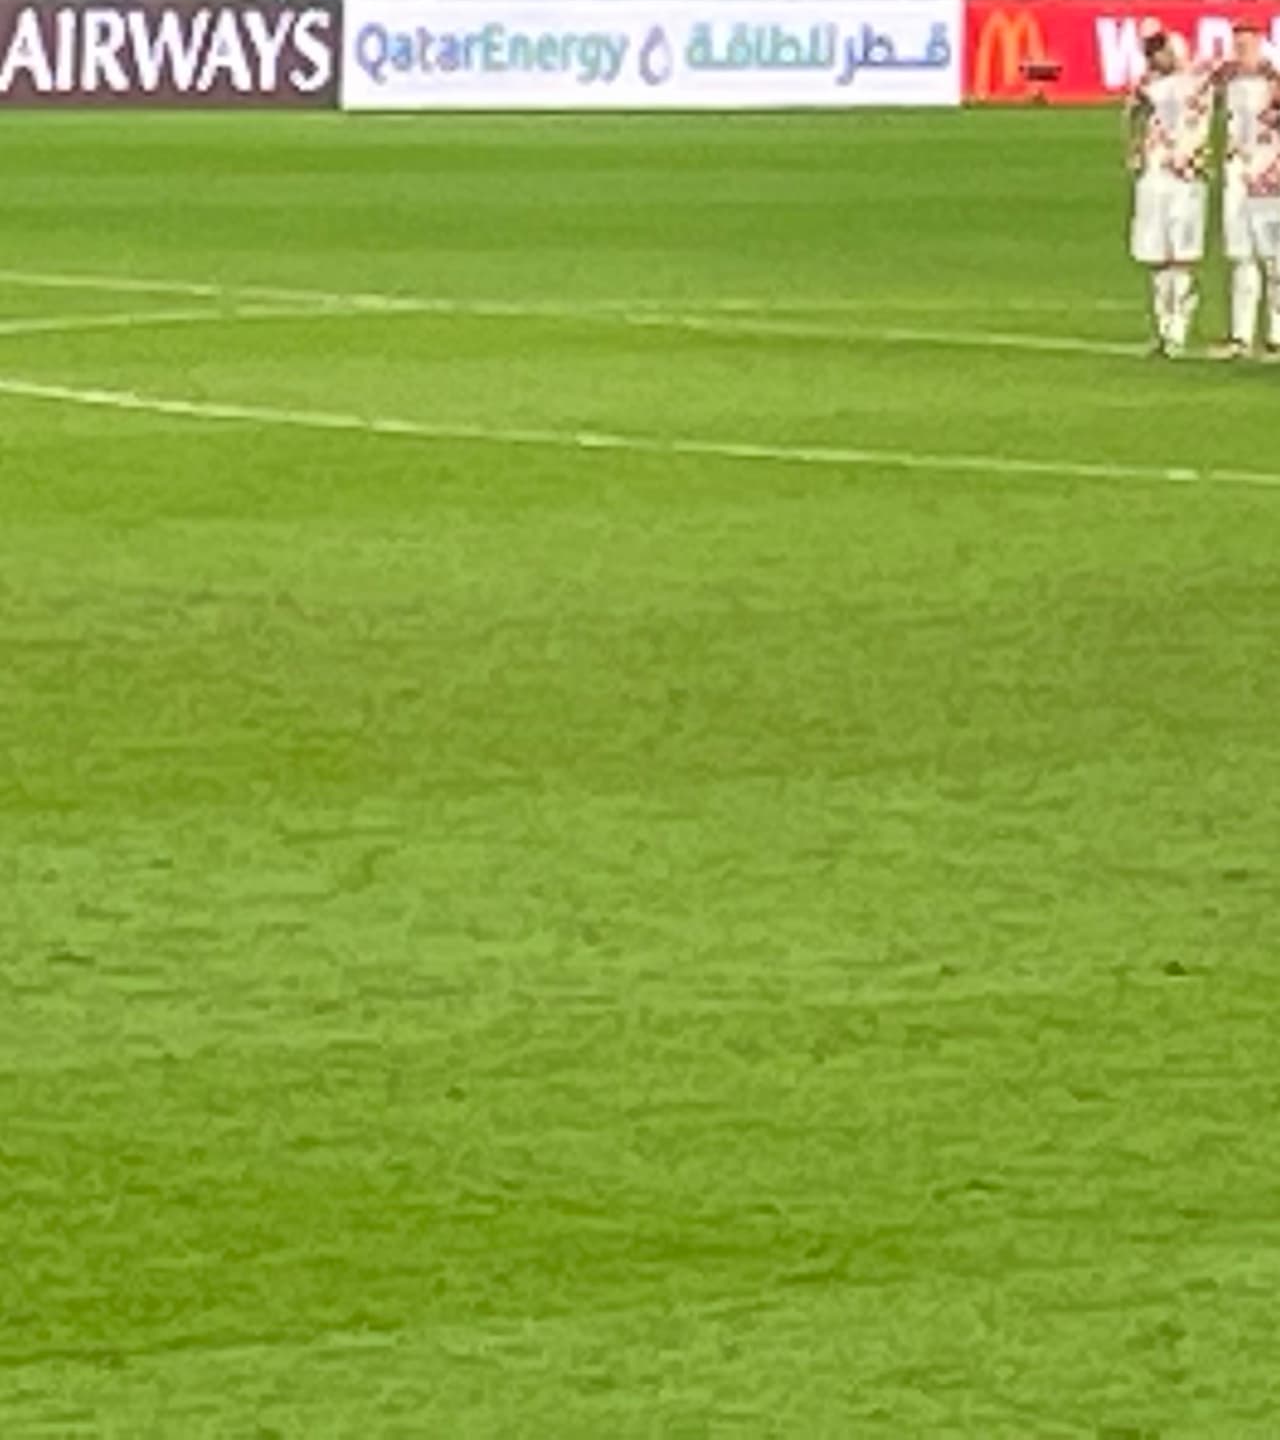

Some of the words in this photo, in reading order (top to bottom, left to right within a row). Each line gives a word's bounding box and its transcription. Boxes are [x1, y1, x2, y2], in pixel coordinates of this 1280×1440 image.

[0, 7, 331, 93] AIRWAYS
[355, 21, 629, 85] QatarEnergy
[685, 21, 836, 71] للطاقة
[836, 21, 952, 86] قطر
